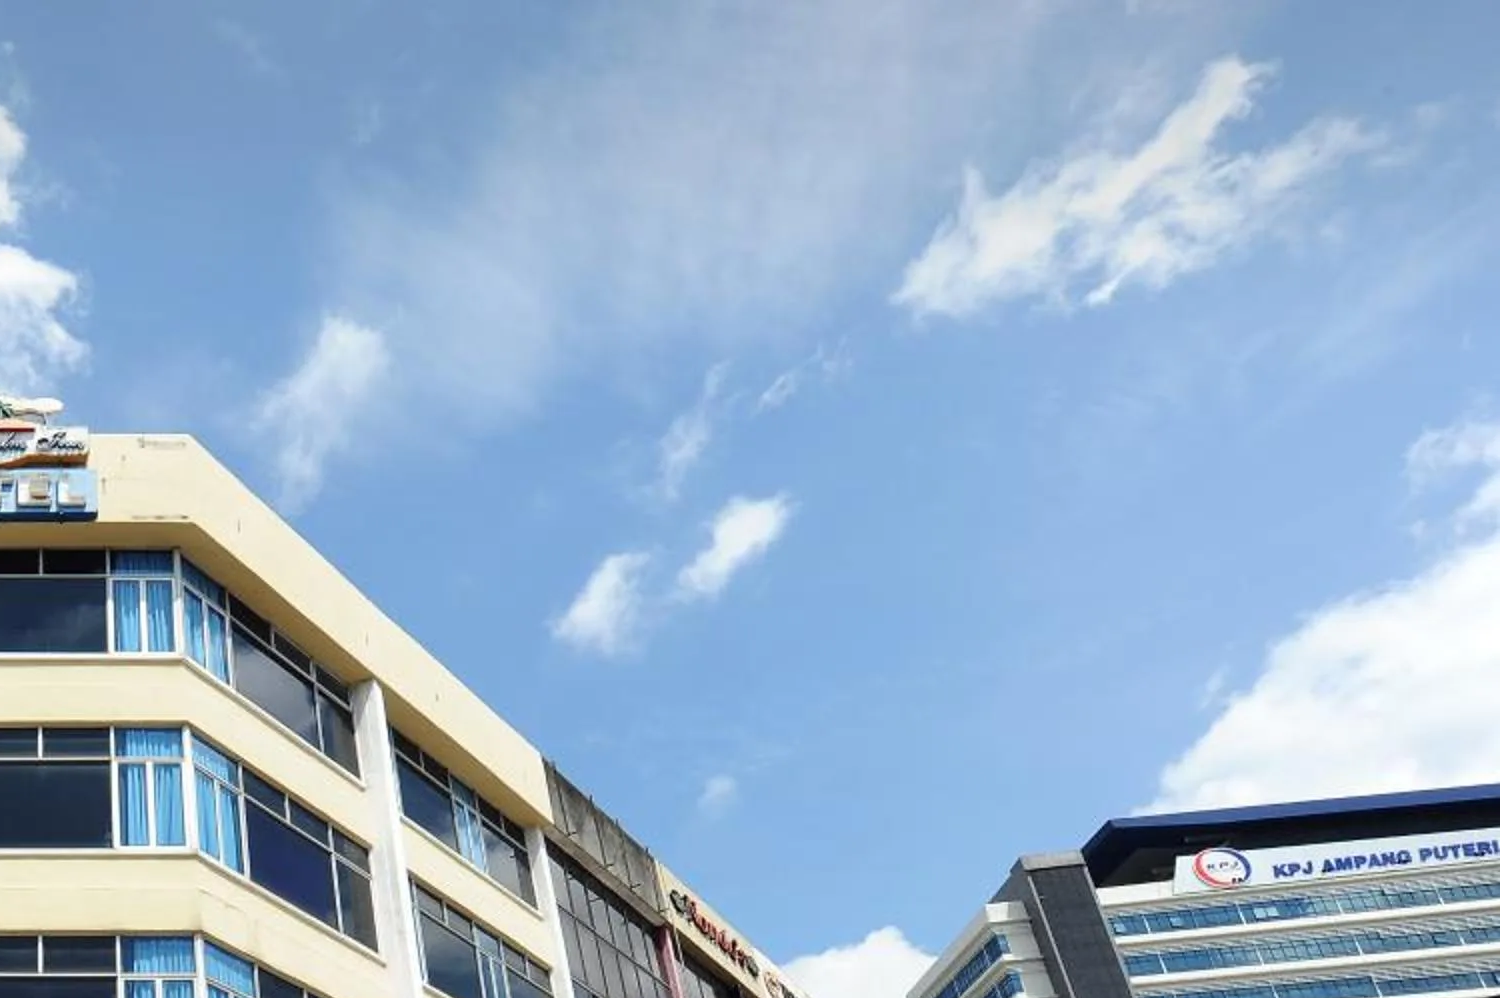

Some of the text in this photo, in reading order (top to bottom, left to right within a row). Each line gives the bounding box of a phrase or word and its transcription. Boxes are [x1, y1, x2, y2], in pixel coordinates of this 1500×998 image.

[1272, 840, 1500, 879] KPJ AMPANG PUTERI
